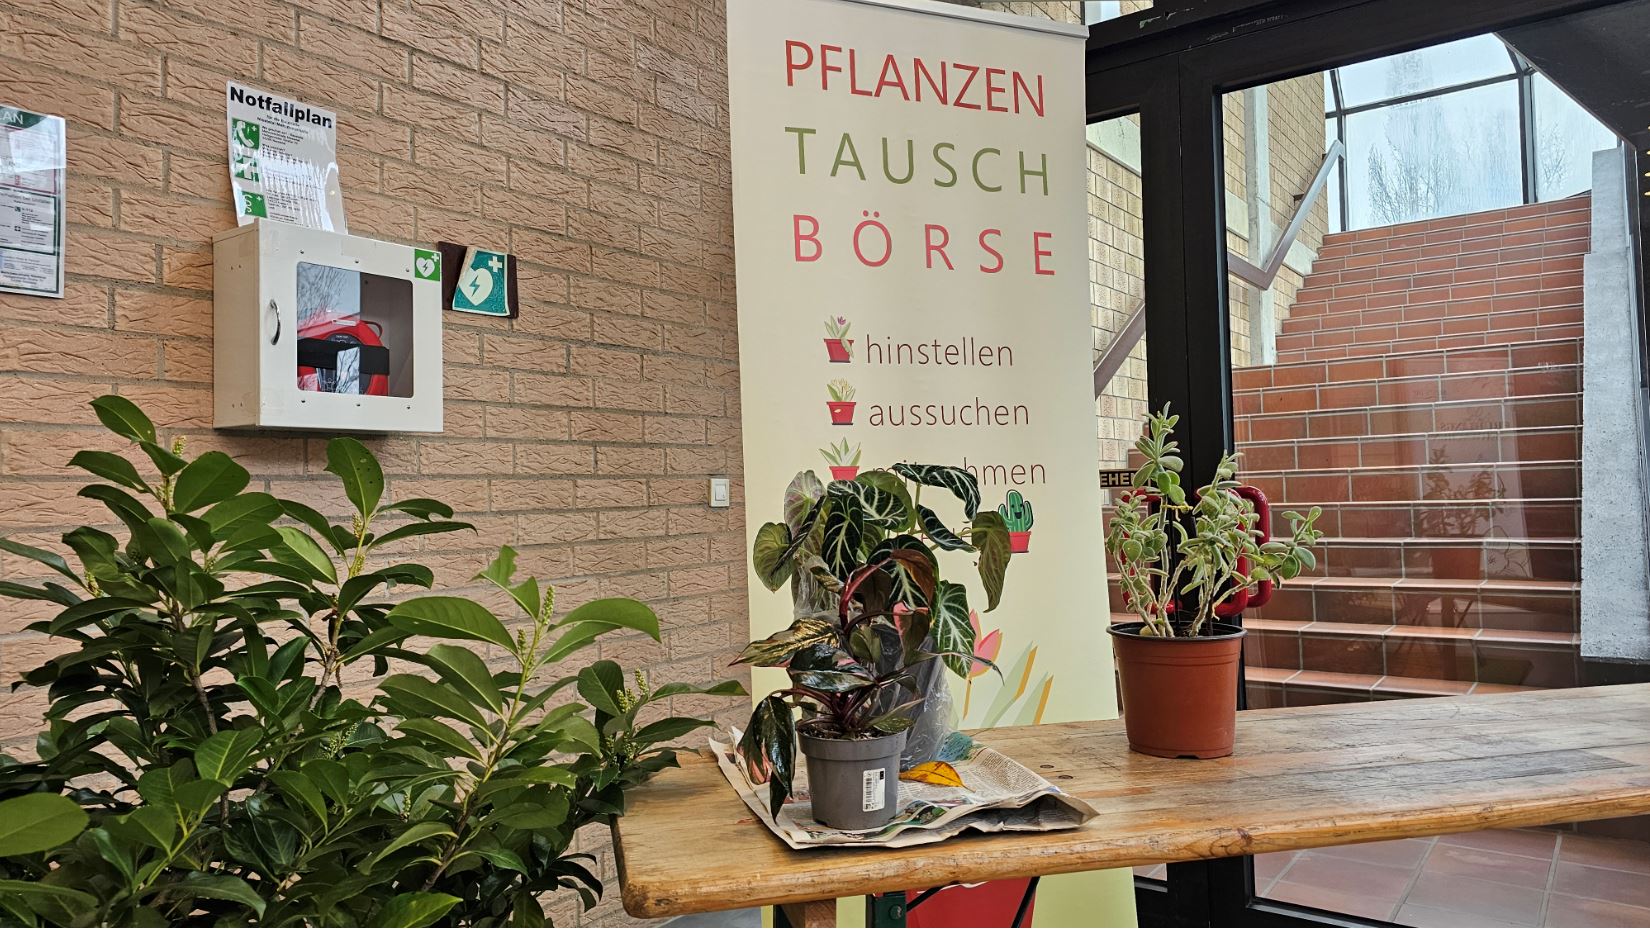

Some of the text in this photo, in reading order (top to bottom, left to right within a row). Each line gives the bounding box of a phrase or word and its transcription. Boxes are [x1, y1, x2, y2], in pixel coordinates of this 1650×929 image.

[785, 39, 1045, 117] PFLANZEN
[230, 86, 332, 128] Notfallplan
[785, 126, 1049, 196] TAUSCH
[793, 209, 1055, 276] BÖRSE
[866, 334, 1013, 366] hinstellen
[869, 397, 1029, 425] aussuchen
[1100, 472, 1135, 487] EHE
